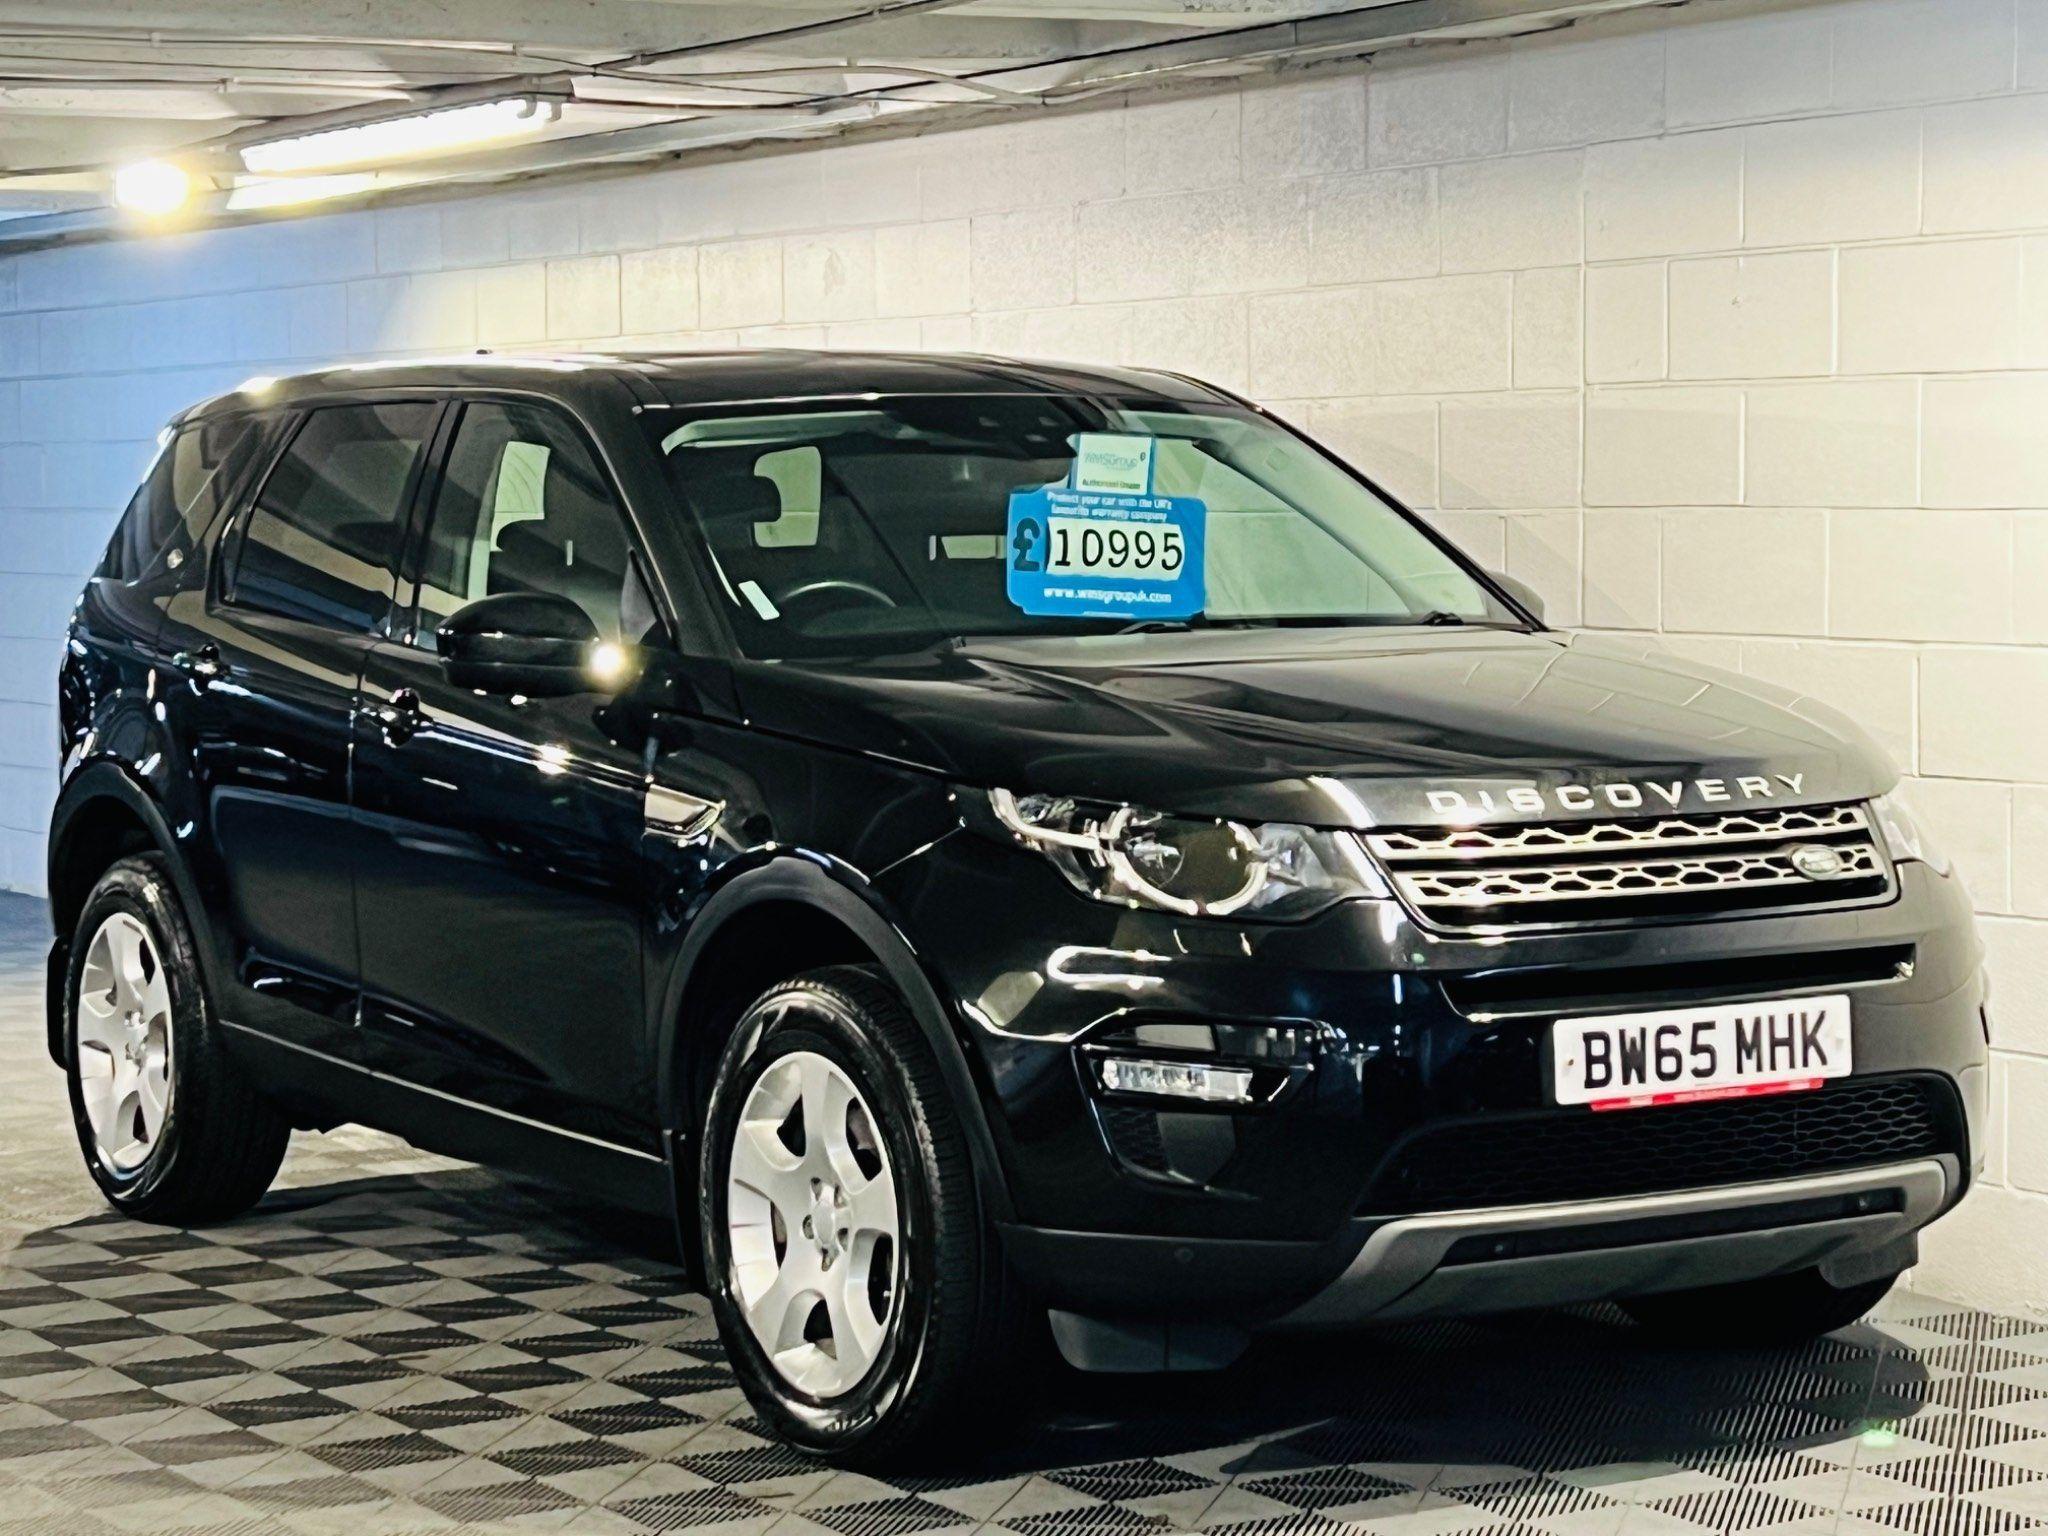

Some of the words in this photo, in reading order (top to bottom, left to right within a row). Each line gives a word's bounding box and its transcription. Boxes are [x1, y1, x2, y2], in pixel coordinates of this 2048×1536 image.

[1047, 491, 1079, 503] Protect
[1082, 496, 1101, 505] your
[1102, 496, 1116, 505] car
[1118, 498, 1137, 506] with
[1139, 499, 1152, 507] the
[1091, 508, 1130, 519] warranty
[1130, 511, 1167, 522] company
[1426, 773, 1804, 814] DISCOVERY
[1582, 1020, 1718, 1089] BW65
[1735, 1010, 1828, 1074] MHK
